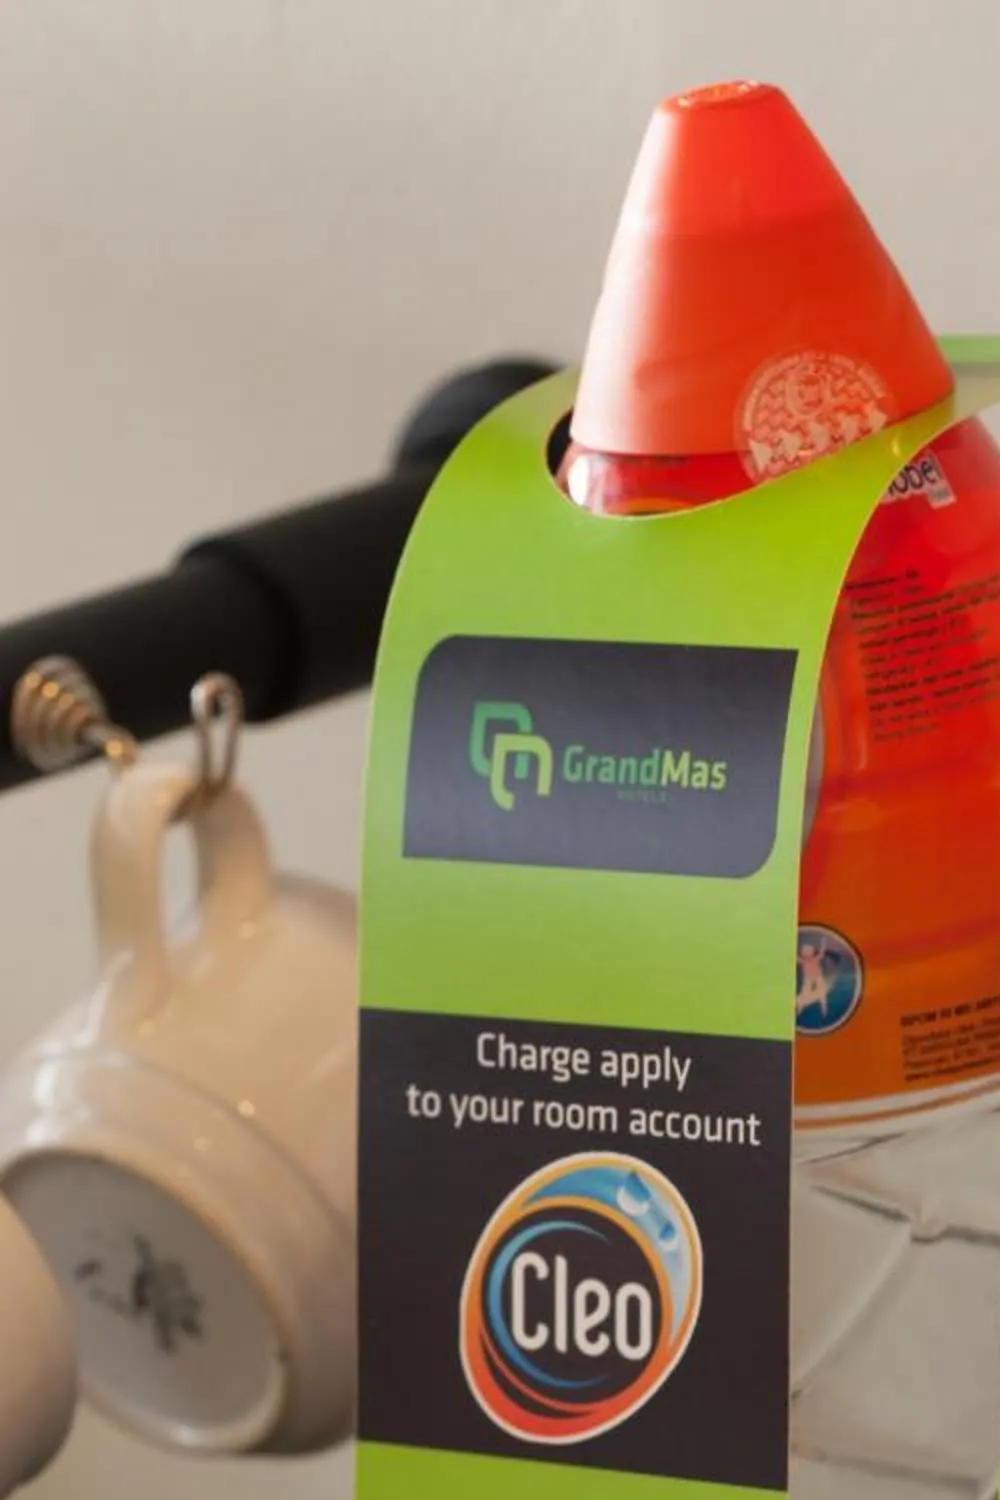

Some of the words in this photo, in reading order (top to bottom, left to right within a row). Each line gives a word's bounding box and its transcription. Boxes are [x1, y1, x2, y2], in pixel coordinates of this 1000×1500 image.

[562, 743, 728, 791] GrandMas
[476, 1031, 590, 1083] Charge
[600, 1046, 692, 1093] apply
[405, 1083, 441, 1118] to
[449, 1092, 524, 1129] your
[532, 1100, 618, 1133] room
[628, 1107, 762, 1146] account
[511, 1251, 654, 1361] Cleo
